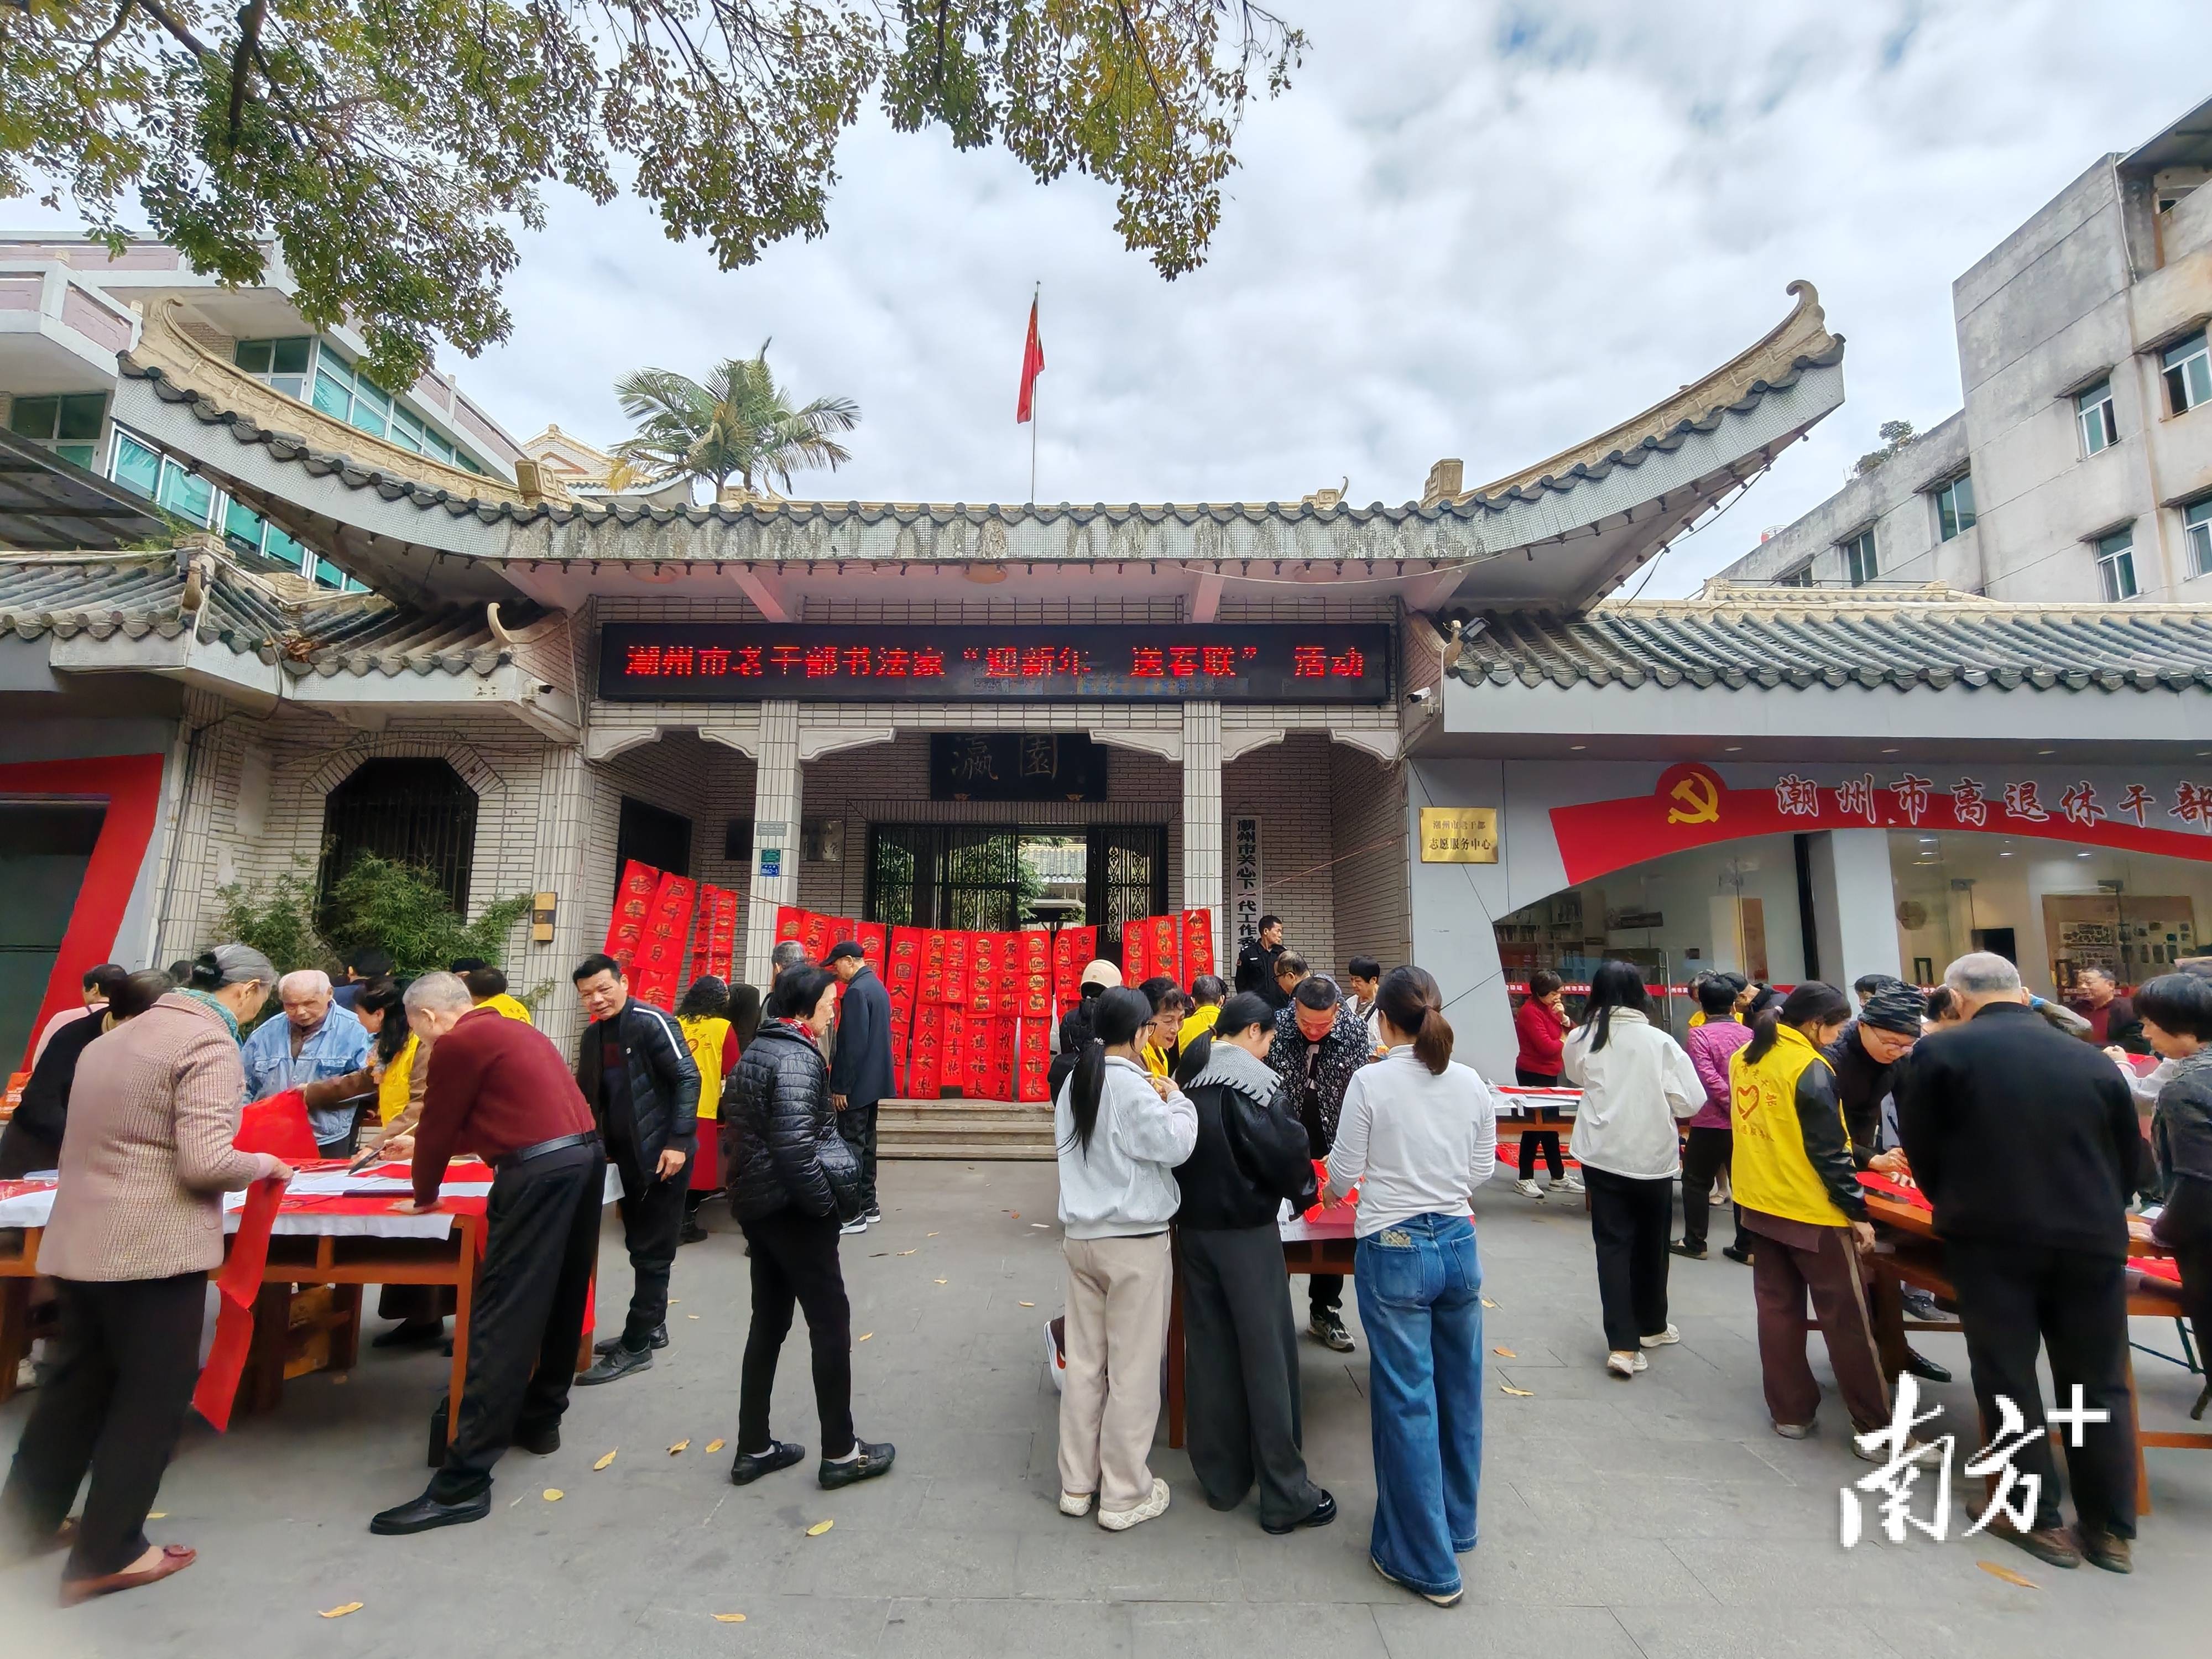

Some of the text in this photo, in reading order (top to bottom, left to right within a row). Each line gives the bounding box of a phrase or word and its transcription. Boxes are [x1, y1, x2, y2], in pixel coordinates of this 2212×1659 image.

[1429, 837, 1491, 851] 志愿服务中心
